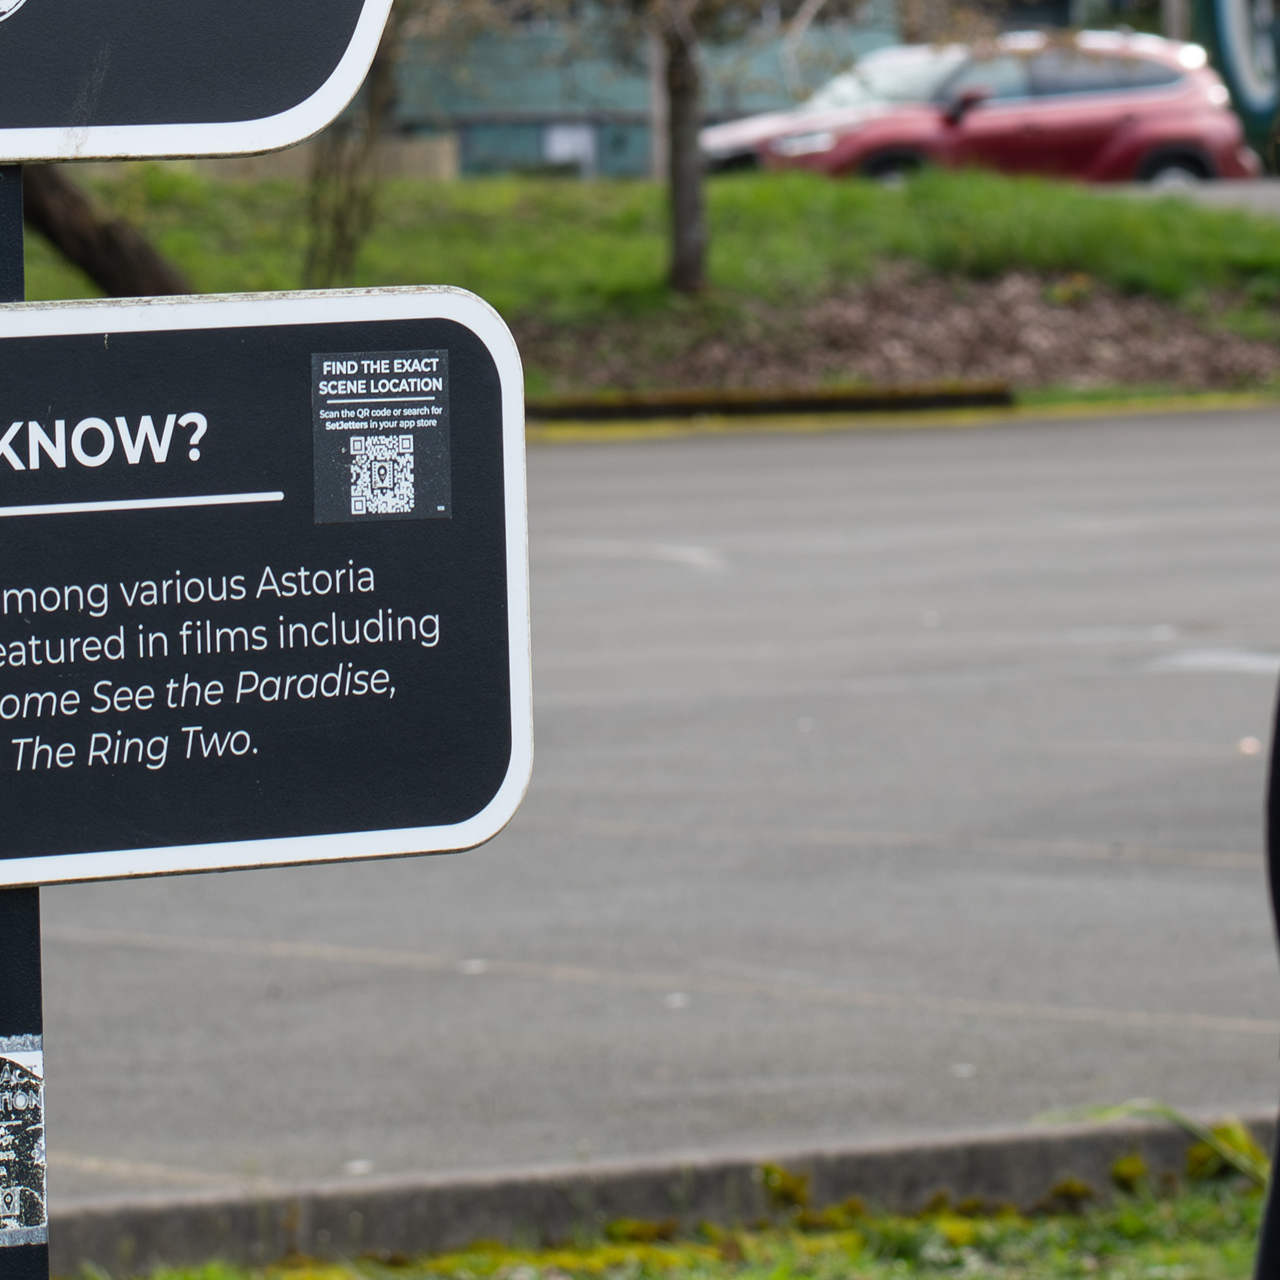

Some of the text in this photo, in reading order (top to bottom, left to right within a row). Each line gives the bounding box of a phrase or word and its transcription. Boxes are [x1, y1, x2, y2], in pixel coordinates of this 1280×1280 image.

[323, 358, 439, 376] FIND THE EXACT
[319, 378, 443, 395] SCENE LOCATION
[319, 406, 443, 419] Scan the QR code or search for
[325, 418, 438, 431] SetJetters in your app store
[120, 570, 246, 606] various
[256, 560, 374, 598] Astoria
[139, 625, 167, 657] in
[180, 620, 267, 654] films
[279, 609, 439, 648] including
[91, 681, 154, 713] See
[167, 674, 223, 708] the
[236, 663, 395, 703] Paradise,
[12, 736, 75, 770] The
[89, 730, 168, 769] Ring
[182, 726, 257, 758] Two.
